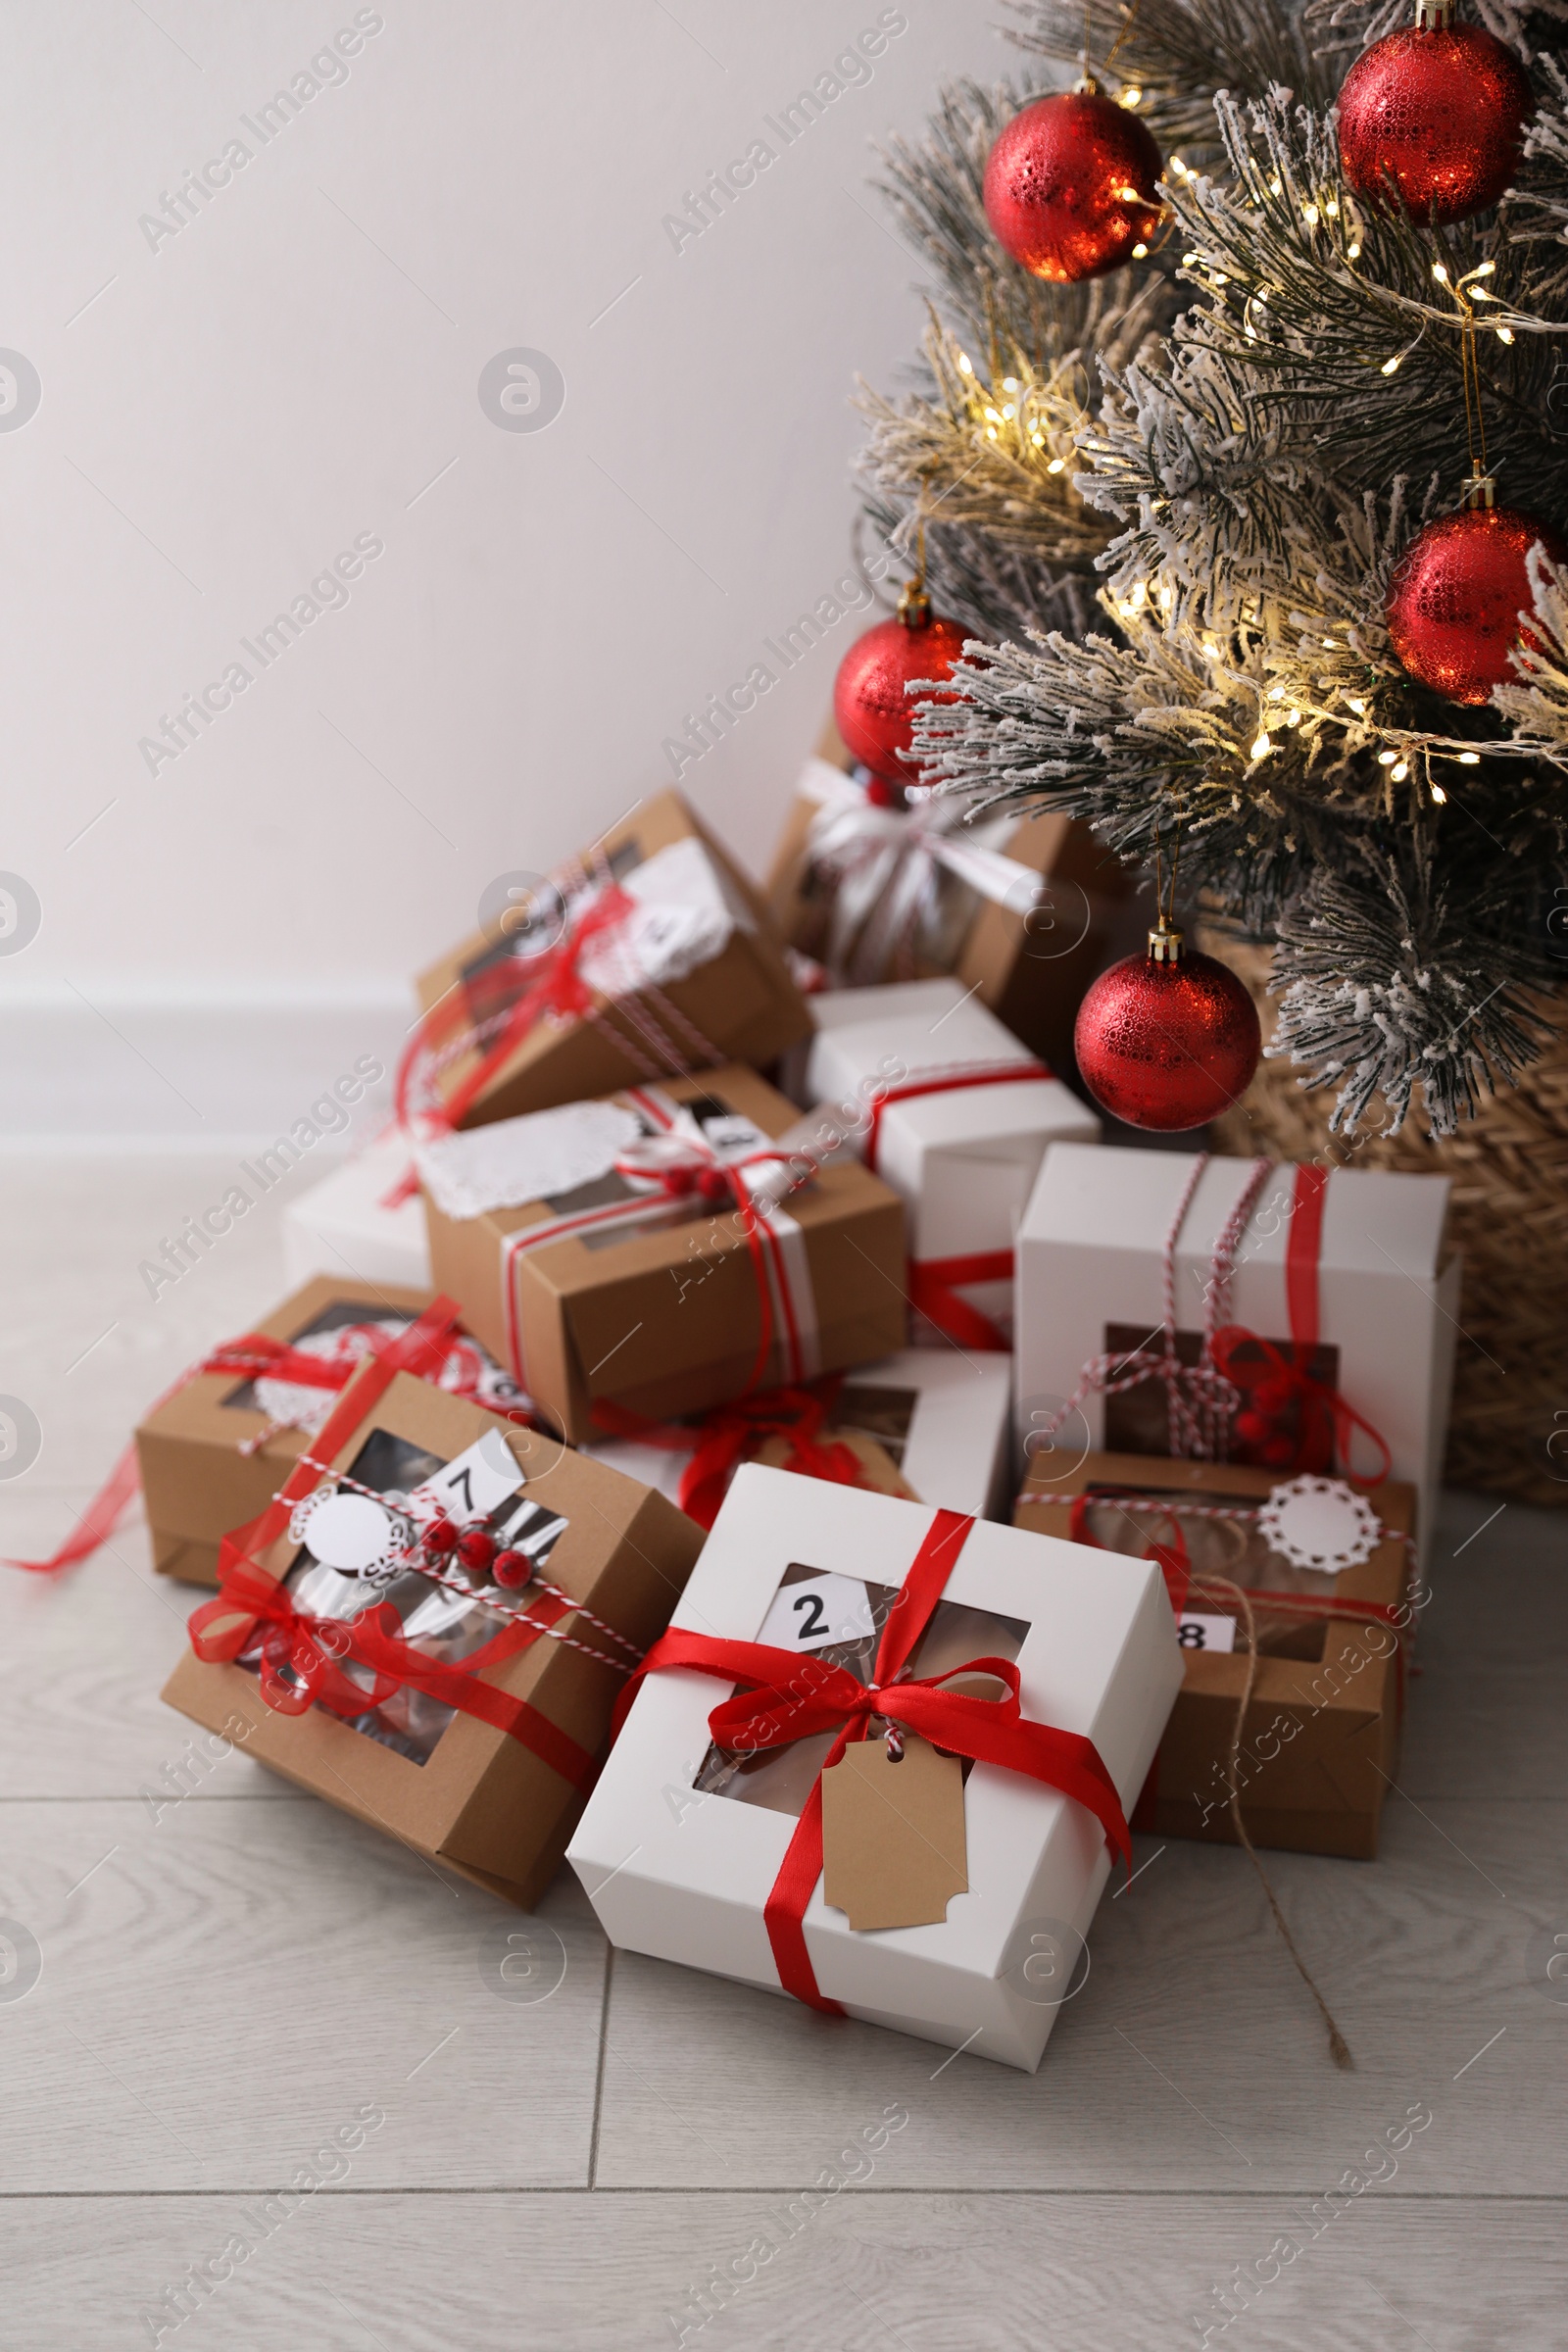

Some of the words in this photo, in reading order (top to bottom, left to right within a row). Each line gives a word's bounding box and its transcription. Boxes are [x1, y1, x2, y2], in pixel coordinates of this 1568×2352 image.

[448, 1467, 474, 1511] 7
[793, 1594, 830, 1640] 2
[1178, 1623, 1206, 1648] 8
